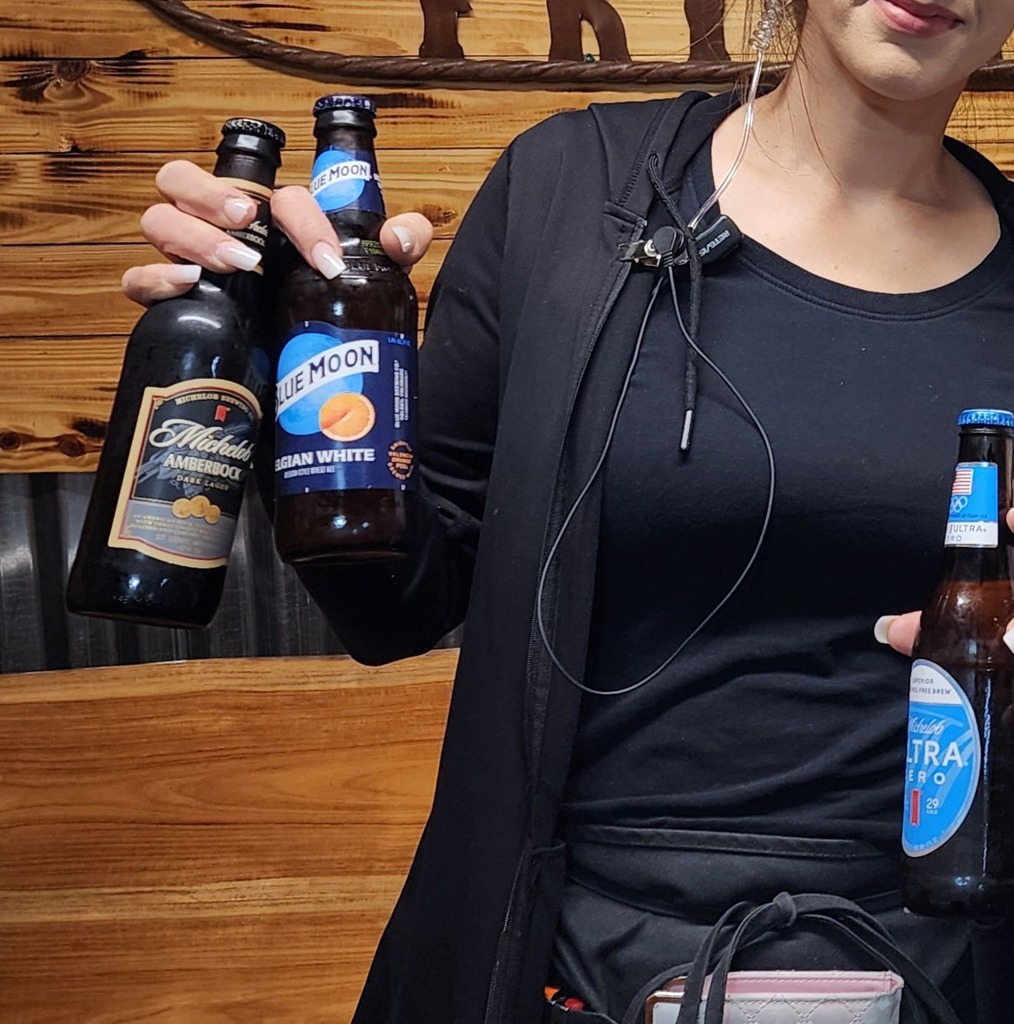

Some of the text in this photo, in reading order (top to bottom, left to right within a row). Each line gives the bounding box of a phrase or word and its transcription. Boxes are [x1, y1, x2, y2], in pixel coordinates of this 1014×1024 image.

[329, 164, 368, 182] MOON
[308, 346, 376, 385] MOON
[149, 418, 255, 461] Michelob
[163, 453, 243, 481] AMBERBOCK
[274, 452, 315, 472] ELGIAN
[317, 448, 376, 464] WHITE
[176, 475, 202, 485] DARK
[953, 524, 983, 533] ULTRA
[911, 677, 934, 685] UPERIOR
[907, 738, 964, 768] TRA
[908, 769, 946, 785] ERO
[925, 797, 939, 809] 29
